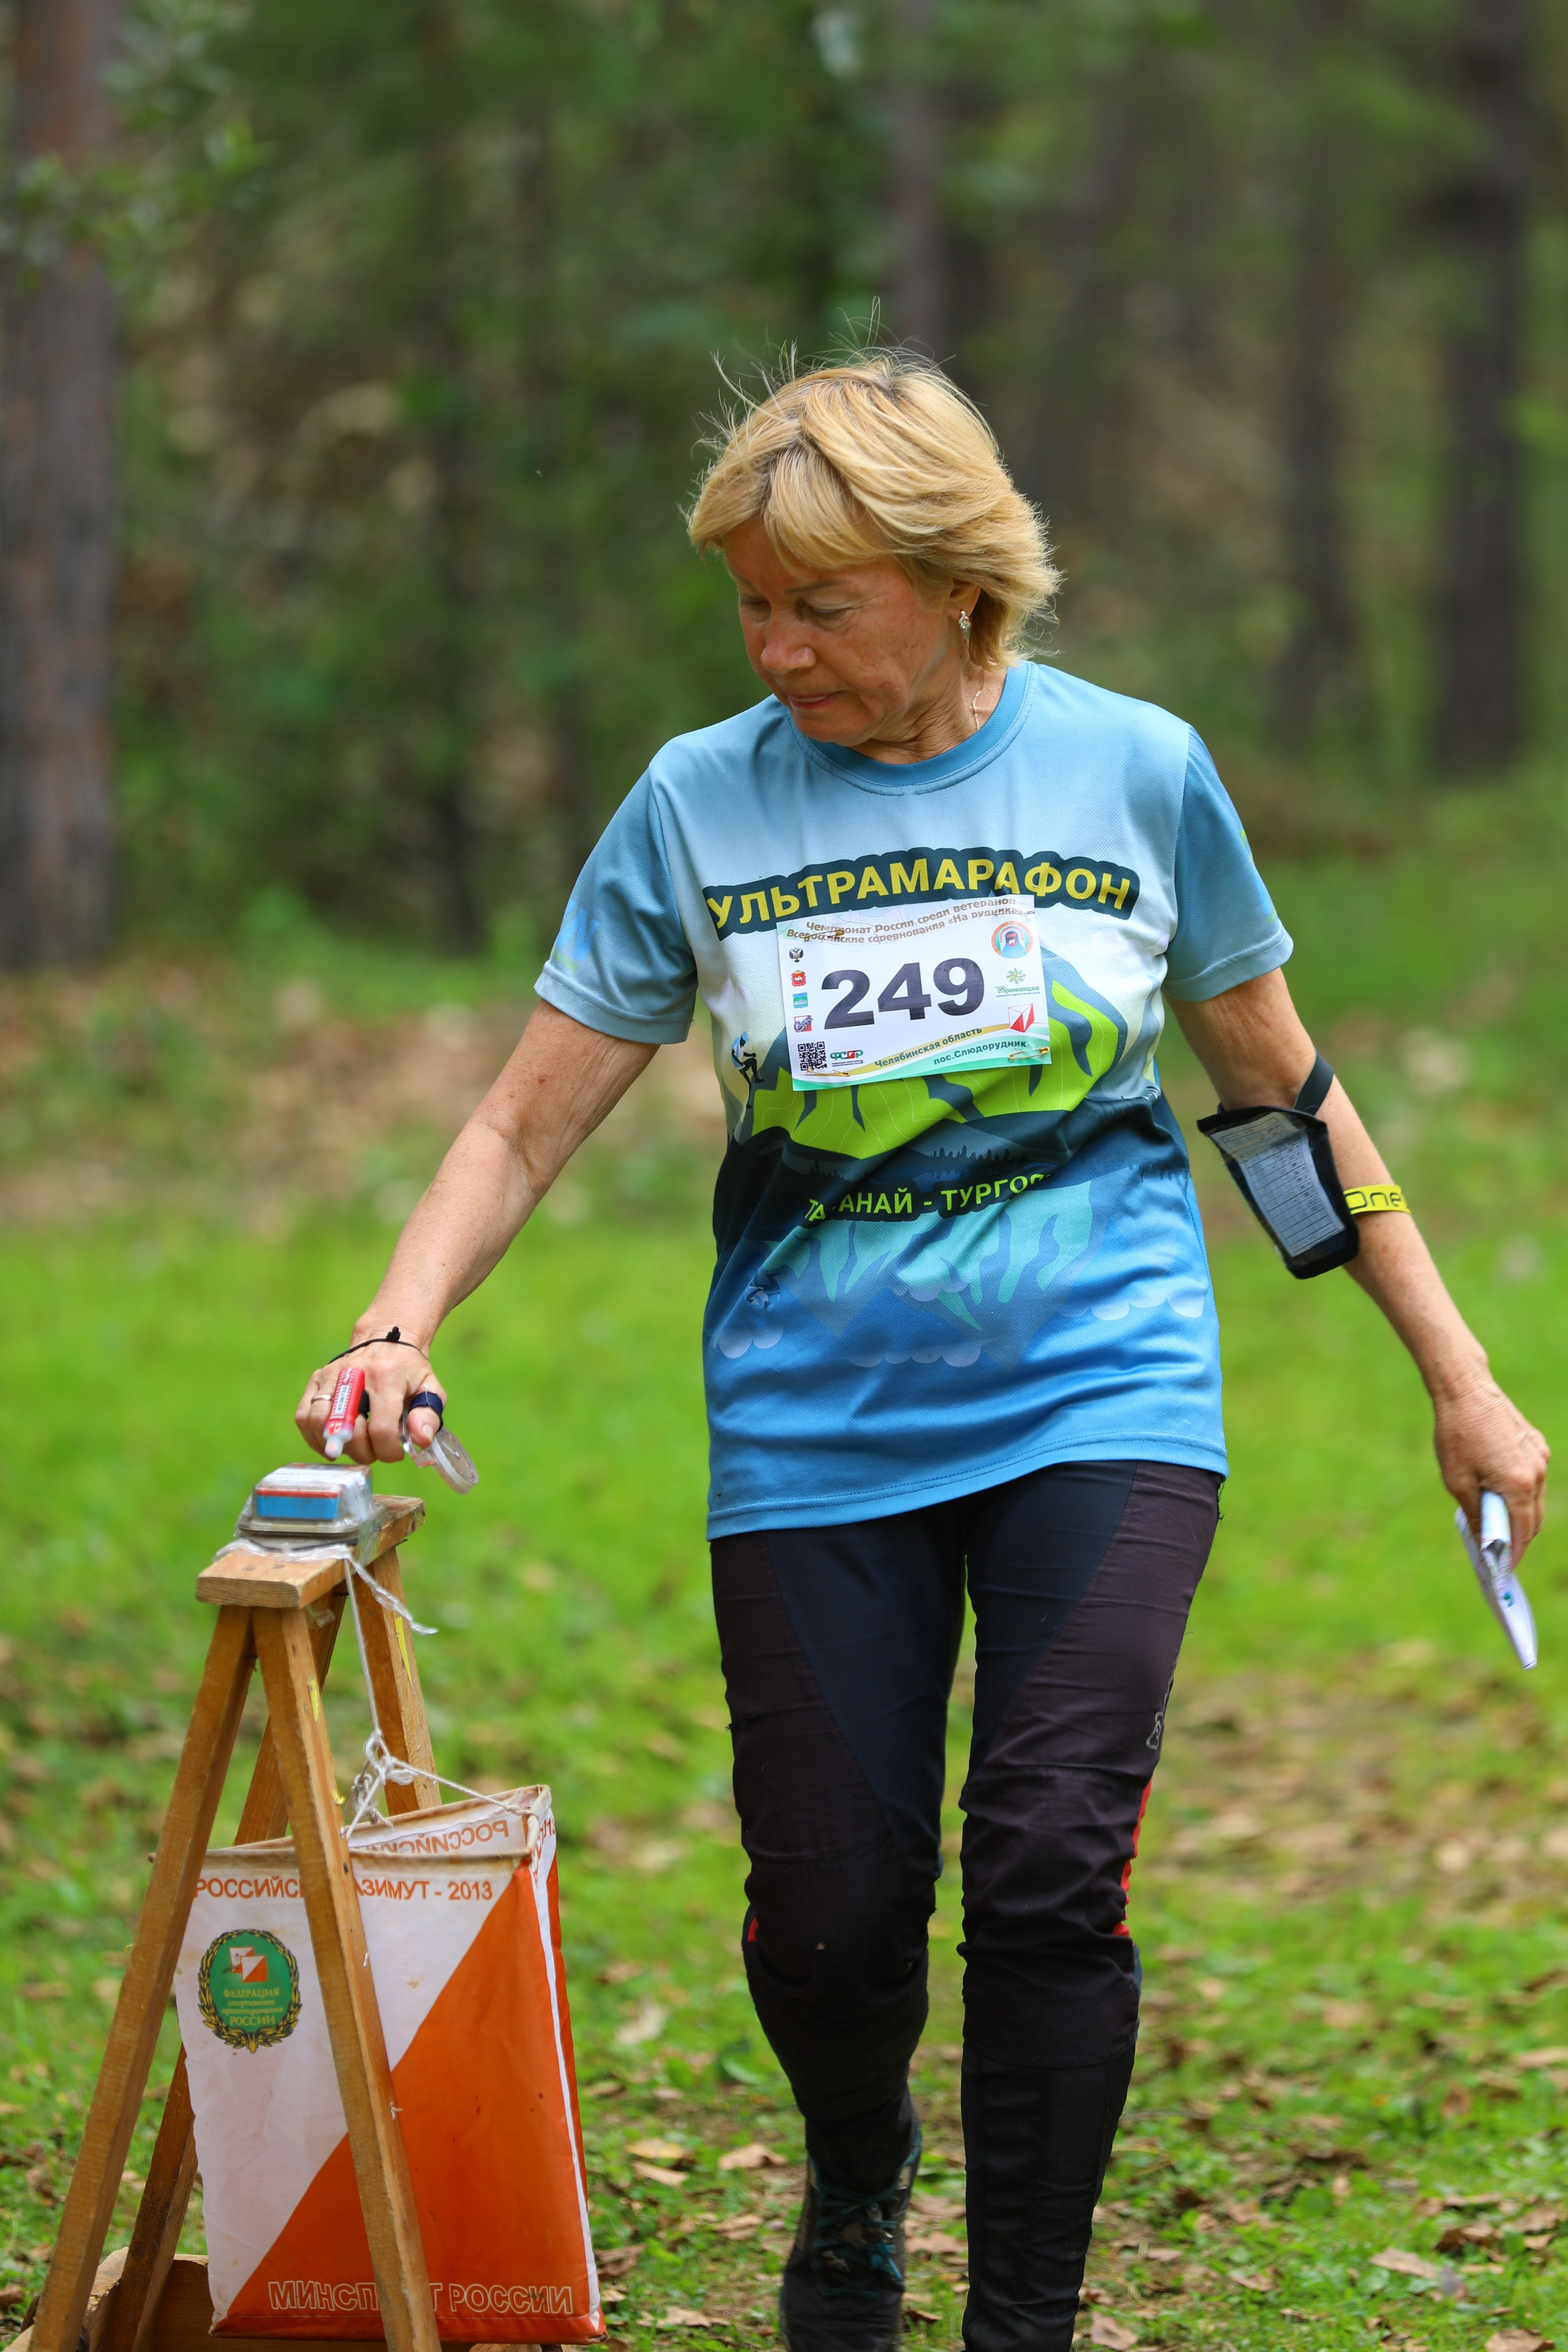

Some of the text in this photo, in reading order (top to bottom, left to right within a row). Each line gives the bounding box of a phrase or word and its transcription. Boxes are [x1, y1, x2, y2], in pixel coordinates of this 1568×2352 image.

[707, 858, 1131, 929] УЛЬТРАМАРАФОН
[868, 920, 945, 943] соревнования
[948, 914, 968, 924] «На
[875, 919, 914, 933] России
[918, 908, 950, 924] среди
[953, 898, 1016, 913] ветеранов
[821, 958, 985, 1030] 249
[875, 1027, 982, 1068] Челябинская область
[933, 1041, 1027, 1065] пос.Слюдорудник
[804, 1188, 912, 1222] ТААНАЙ
[447, 1881, 493, 1901] 2013
[224, 1988, 279, 1999] ФЕДЕРАЦИЯ
[229, 2015, 276, 2026] РОССИИ
[449, 2283, 573, 2314] РОССИИ
